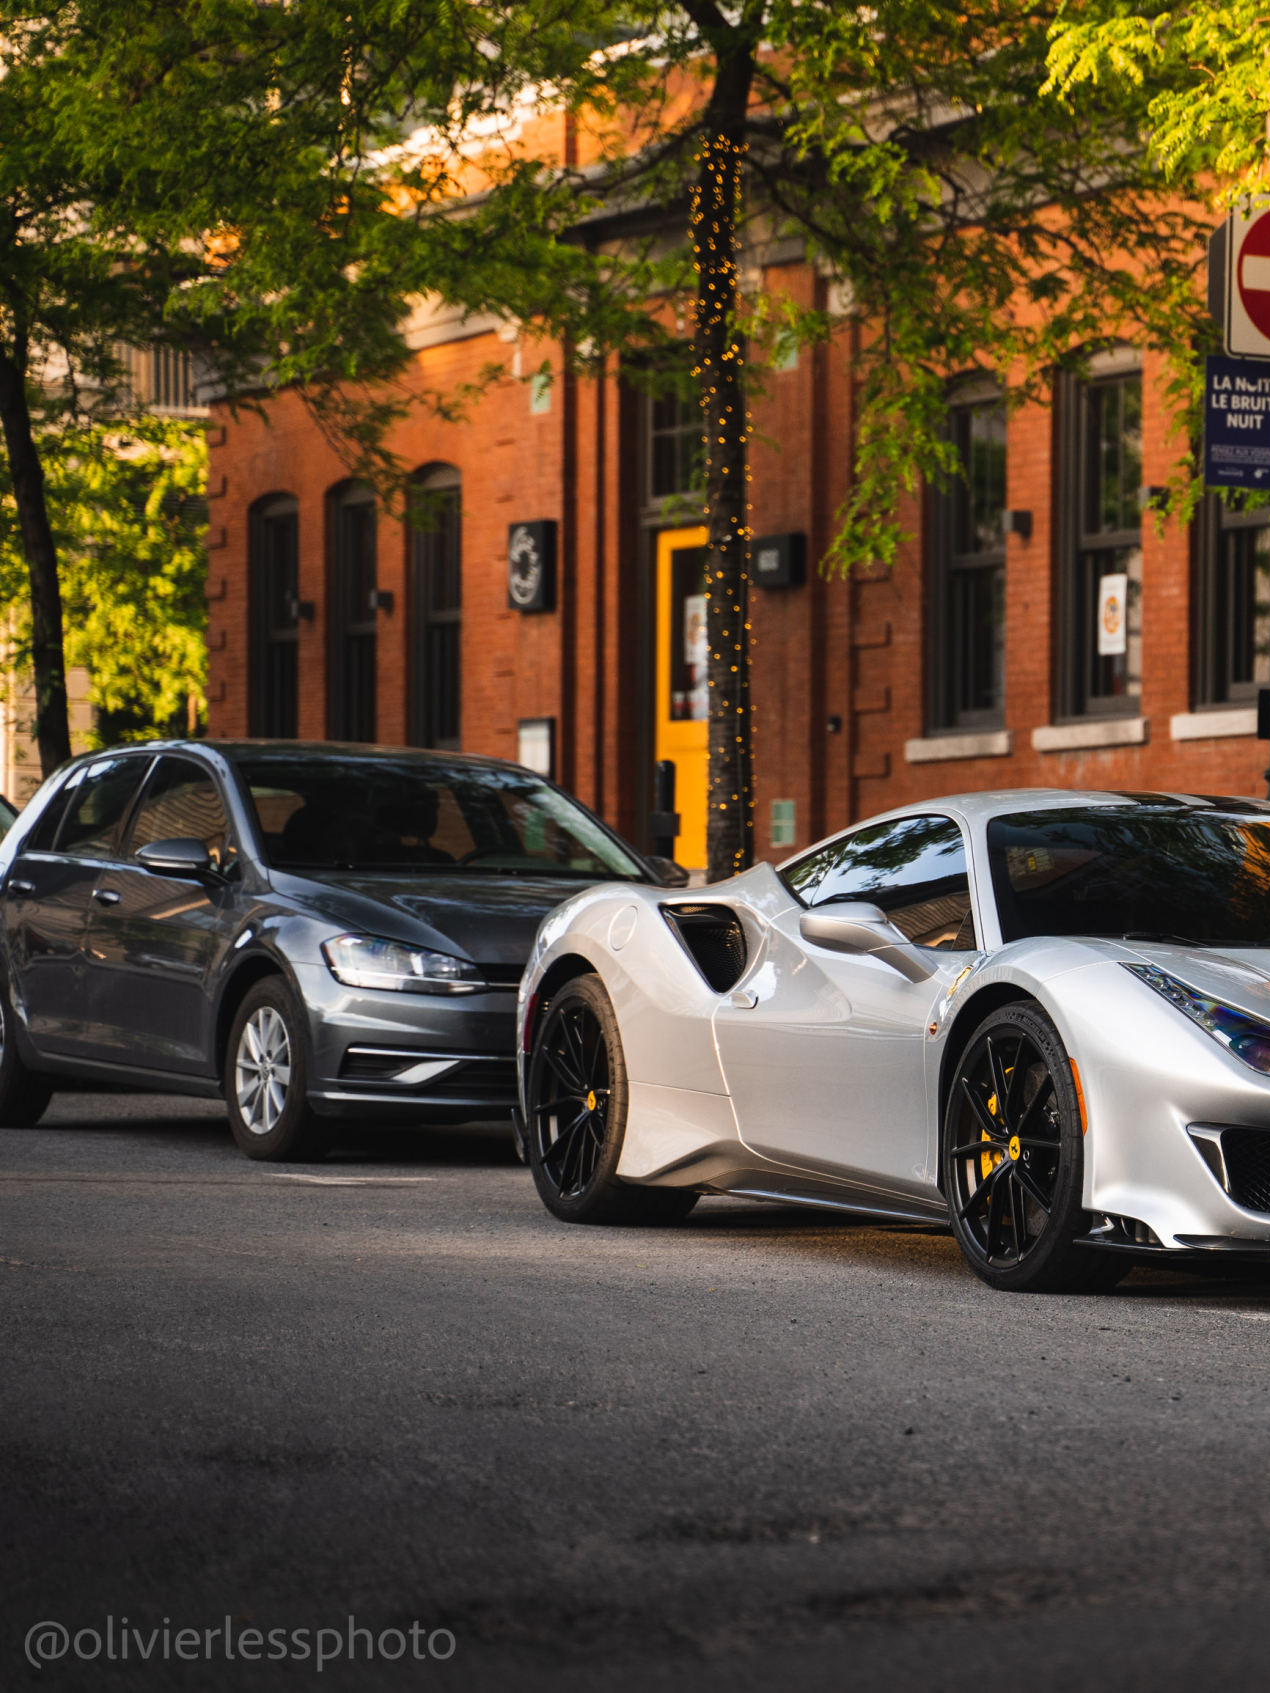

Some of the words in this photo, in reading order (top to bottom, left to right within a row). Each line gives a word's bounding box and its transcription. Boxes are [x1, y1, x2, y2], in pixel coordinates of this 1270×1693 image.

[1212, 374, 1232, 391] LA
[1211, 393, 1228, 409] LE
[1226, 413, 1264, 430] NUIT
[1022, 1015, 1047, 1043] MICHELIN
